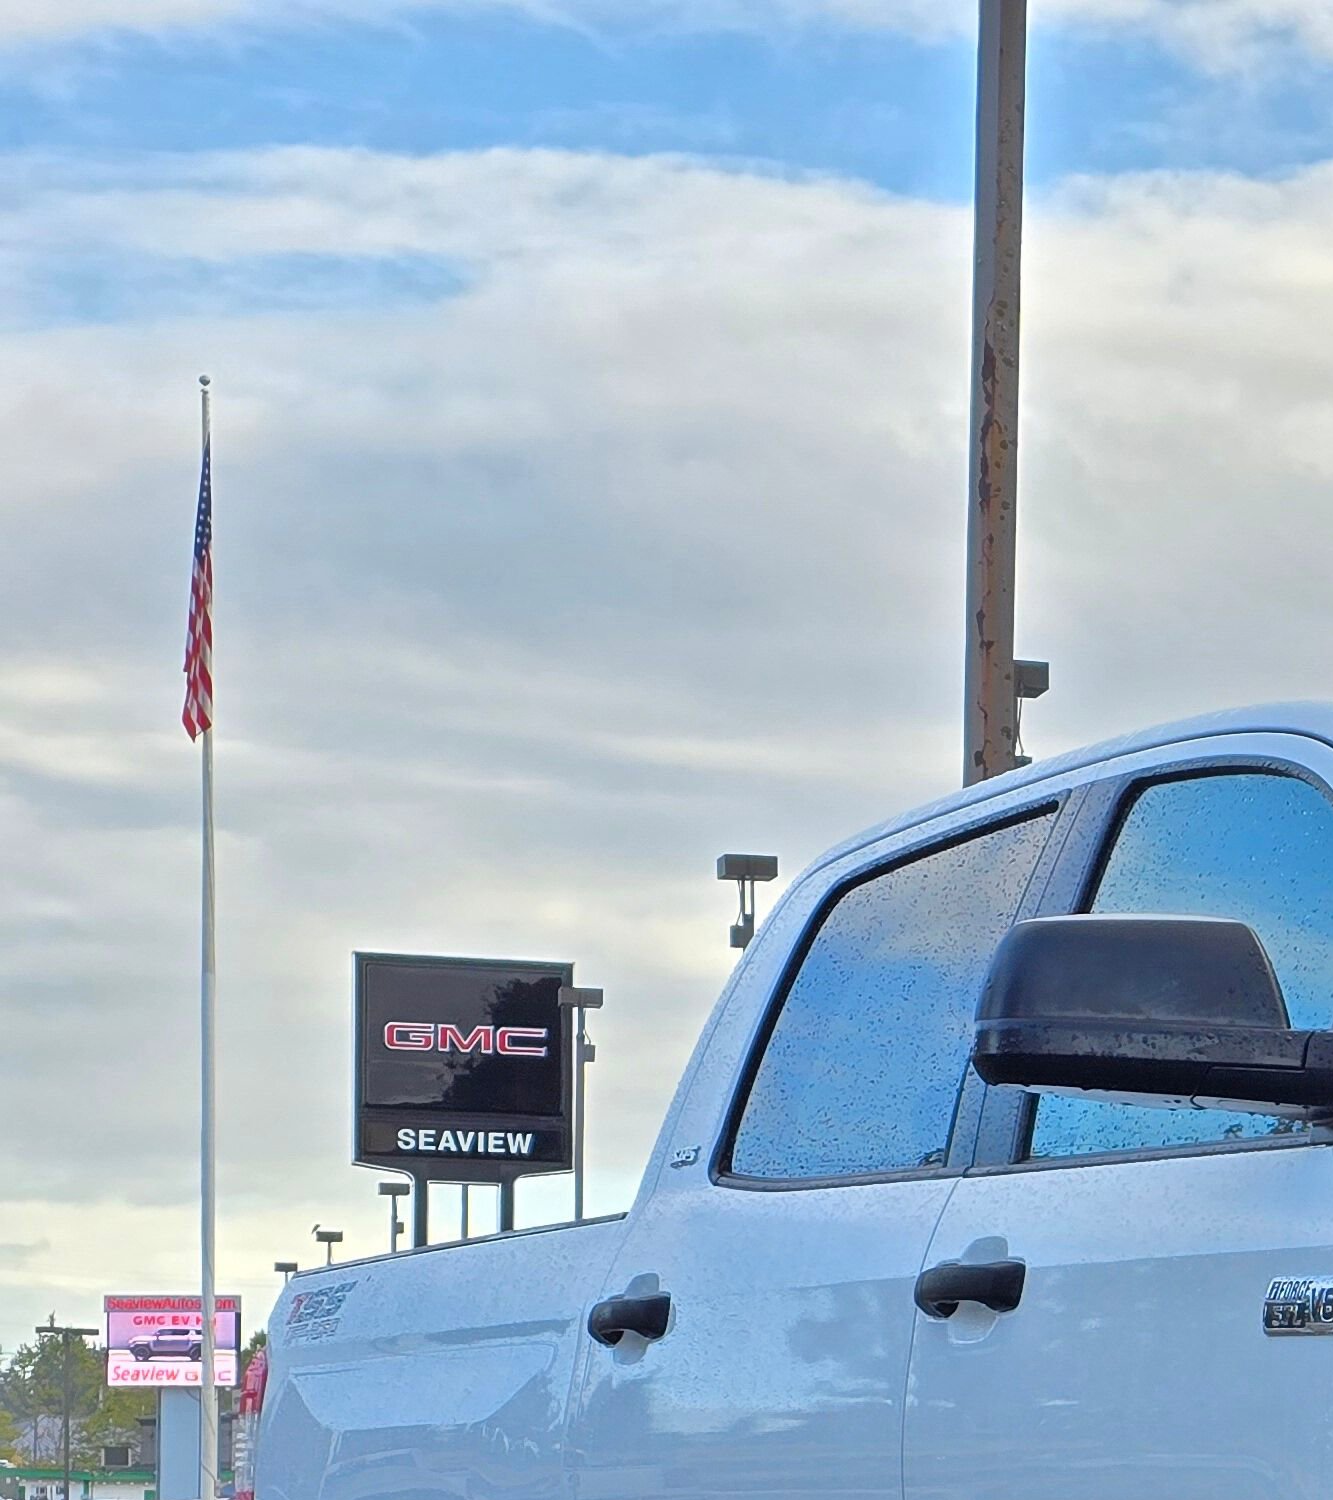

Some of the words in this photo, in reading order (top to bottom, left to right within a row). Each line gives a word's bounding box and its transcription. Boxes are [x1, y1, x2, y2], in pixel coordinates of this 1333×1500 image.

[384, 1021, 548, 1057] GMC
[397, 1129, 533, 1154] SEAVIEW
[132, 1315, 165, 1326] GMC
[171, 1315, 190, 1326] EV
[111, 1365, 180, 1381] Seaview
[184, 1370, 232, 1381] GC
